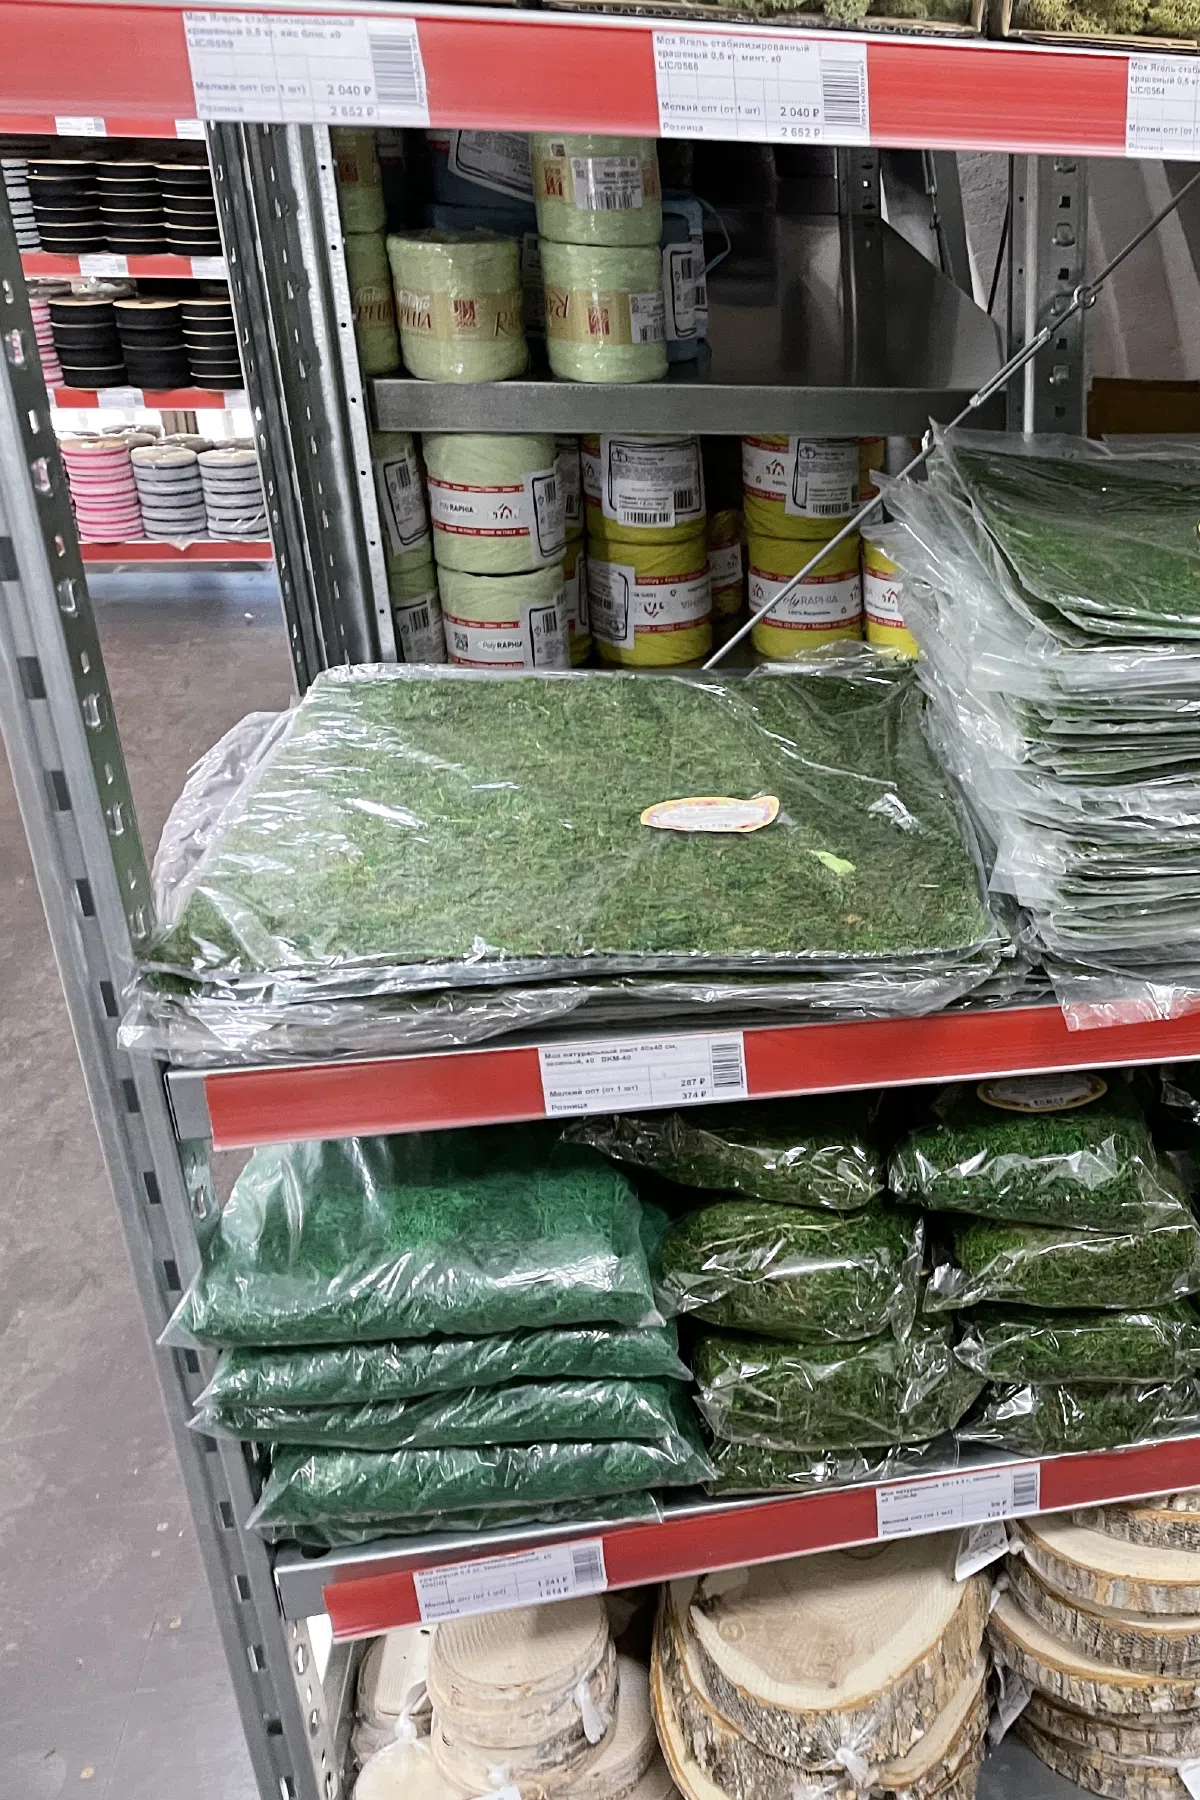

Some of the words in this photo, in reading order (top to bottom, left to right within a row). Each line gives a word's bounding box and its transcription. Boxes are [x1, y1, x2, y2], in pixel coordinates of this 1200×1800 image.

[656, 36, 676, 45] Мох
[679, 37, 708, 47] Ягель
[711, 40, 810, 52] стабилизированный
[1131, 62, 1148, 71] Мох
[1150, 64, 1176, 73] Ягель
[337, 85, 360, 96] 040
[661, 102, 698, 112] Мелкий
[701, 105, 717, 114] опт
[721, 105, 734, 115] (от
[745, 106, 761, 116] шт)
[790, 108, 810, 118] 040
[663, 123, 704, 132] Розница
[791, 128, 811, 137] 652
[1129, 123, 1161, 133] Мелкий
[1164, 127, 1178, 135] опт
[1181, 126, 1193, 135] (от
[681, 1079, 697, 1087] 287
[549, 1088, 583, 1097] Мелкий
[602, 1086, 615, 1095] (от
[682, 1091, 698, 1099] 374
[551, 1103, 588, 1111] Розница
